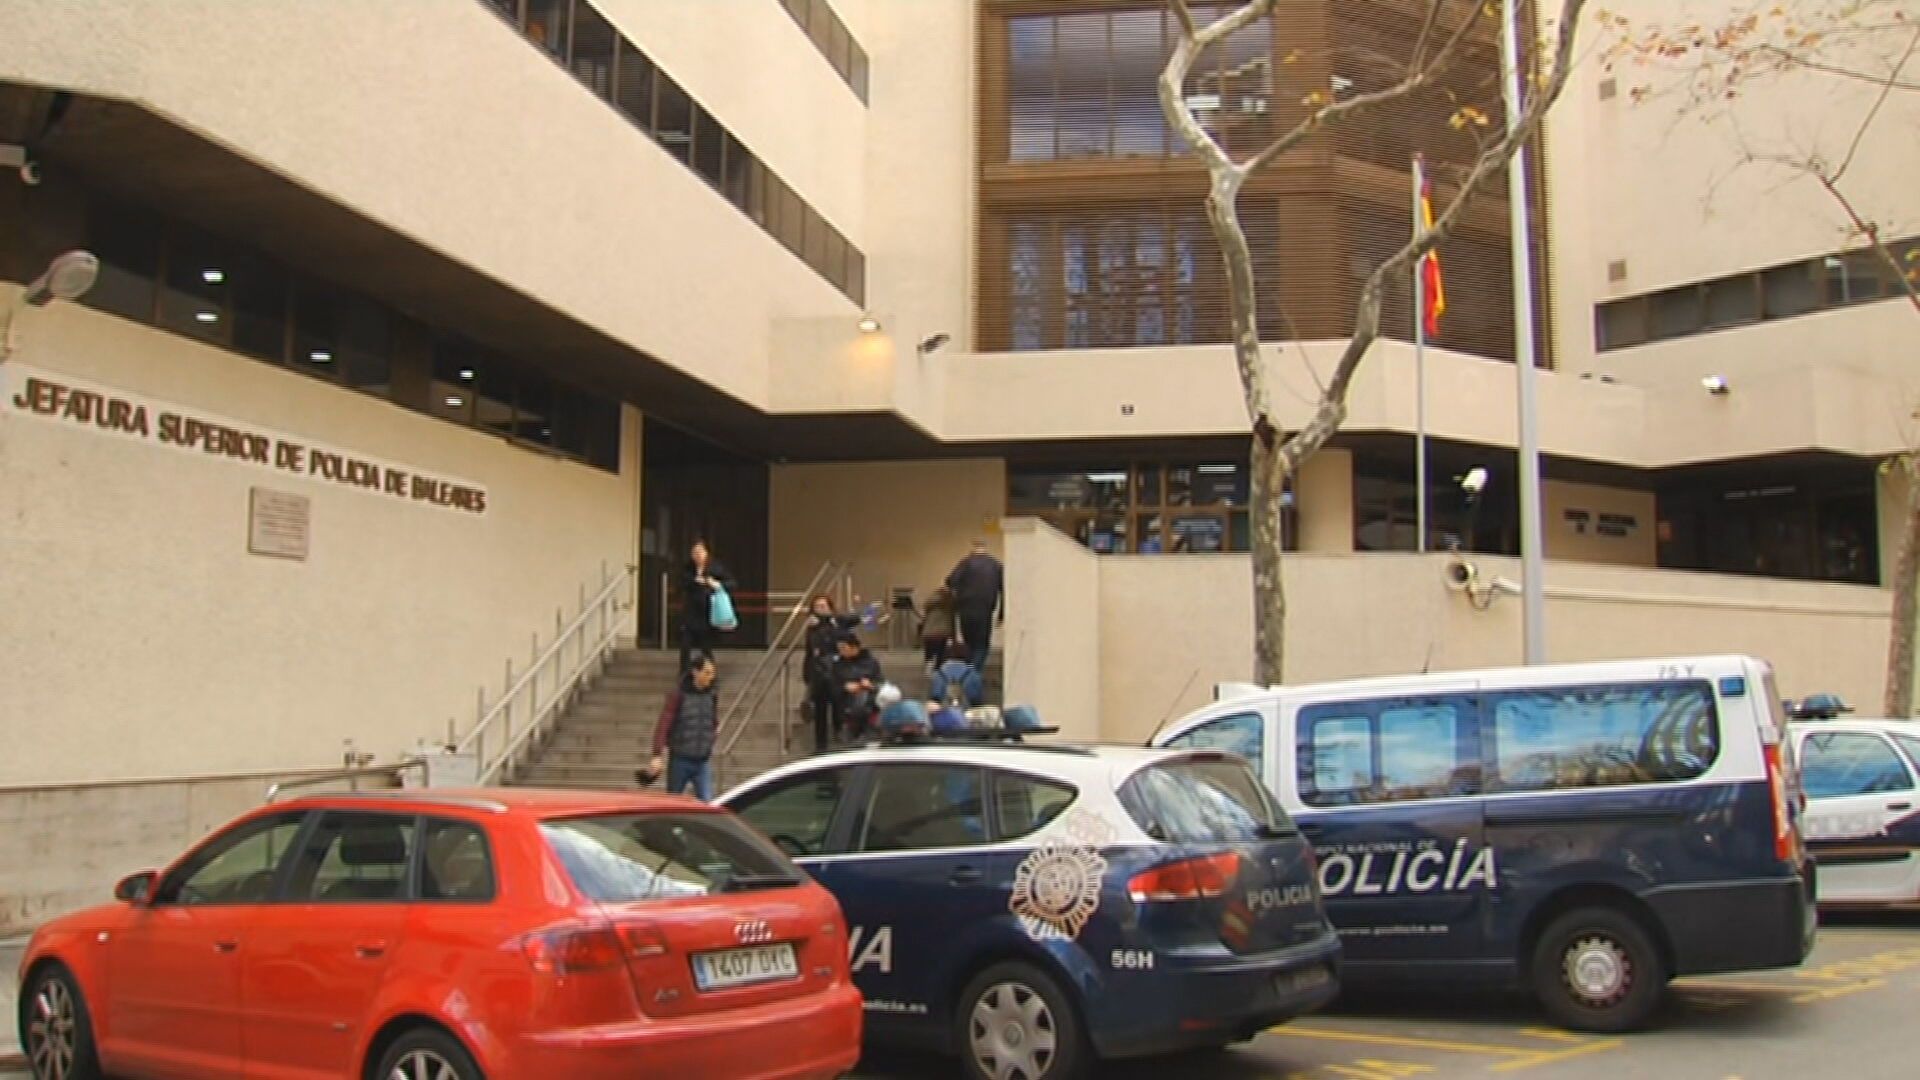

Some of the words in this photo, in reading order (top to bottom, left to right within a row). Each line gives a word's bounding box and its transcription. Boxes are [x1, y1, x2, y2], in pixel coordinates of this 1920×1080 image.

[13, 377, 149, 437] JEFATURA
[158, 413, 270, 464] SUPERIOR
[275, 440, 304, 472] DE
[309, 449, 380, 490] POLICIA
[385, 469, 408, 496] DE
[1318, 837, 1497, 896] OLICÍA
[1111, 949, 1154, 969] 56H
